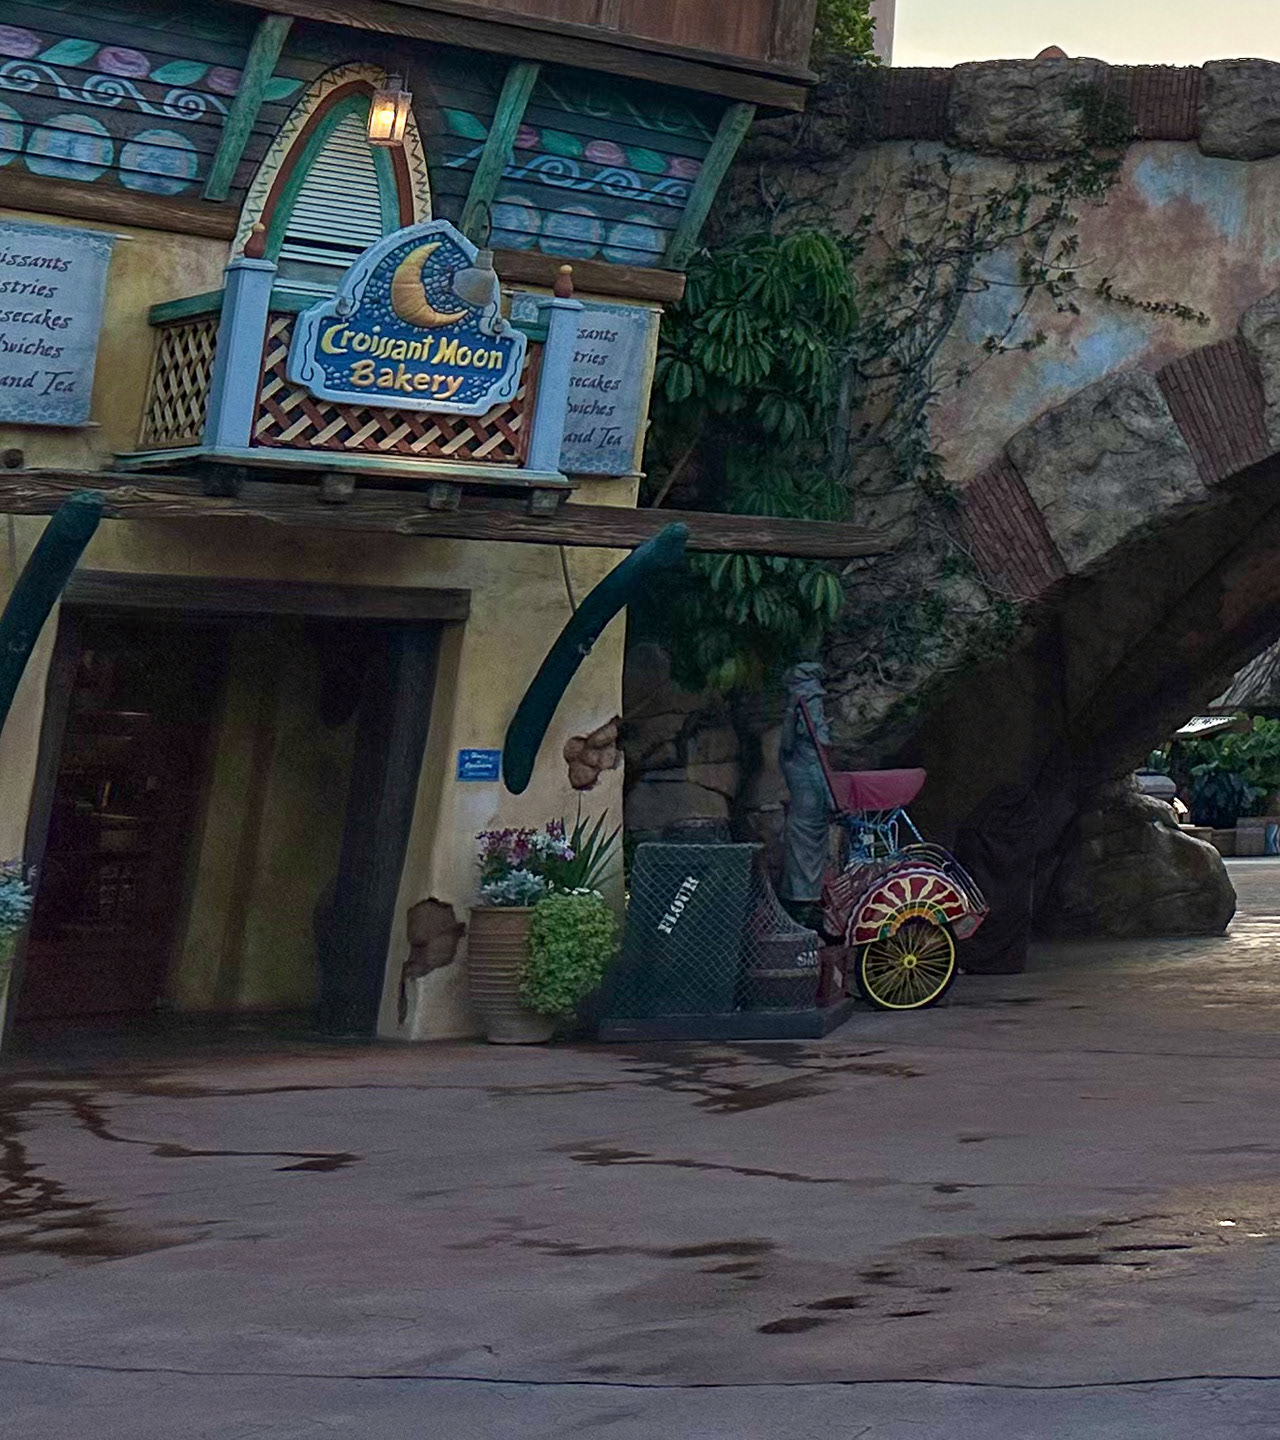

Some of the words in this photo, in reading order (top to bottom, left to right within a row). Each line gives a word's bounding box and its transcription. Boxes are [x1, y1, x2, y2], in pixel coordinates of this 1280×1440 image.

[320, 323, 435, 361] Croissant
[430, 337, 504, 370] Moon
[0, 371, 39, 389] and
[38, 371, 77, 396] Tea
[350, 359, 465, 399] Bakery
[563, 426, 595, 444] and
[596, 426, 623, 449] Tea
[658, 876, 700, 934] FLOUR
